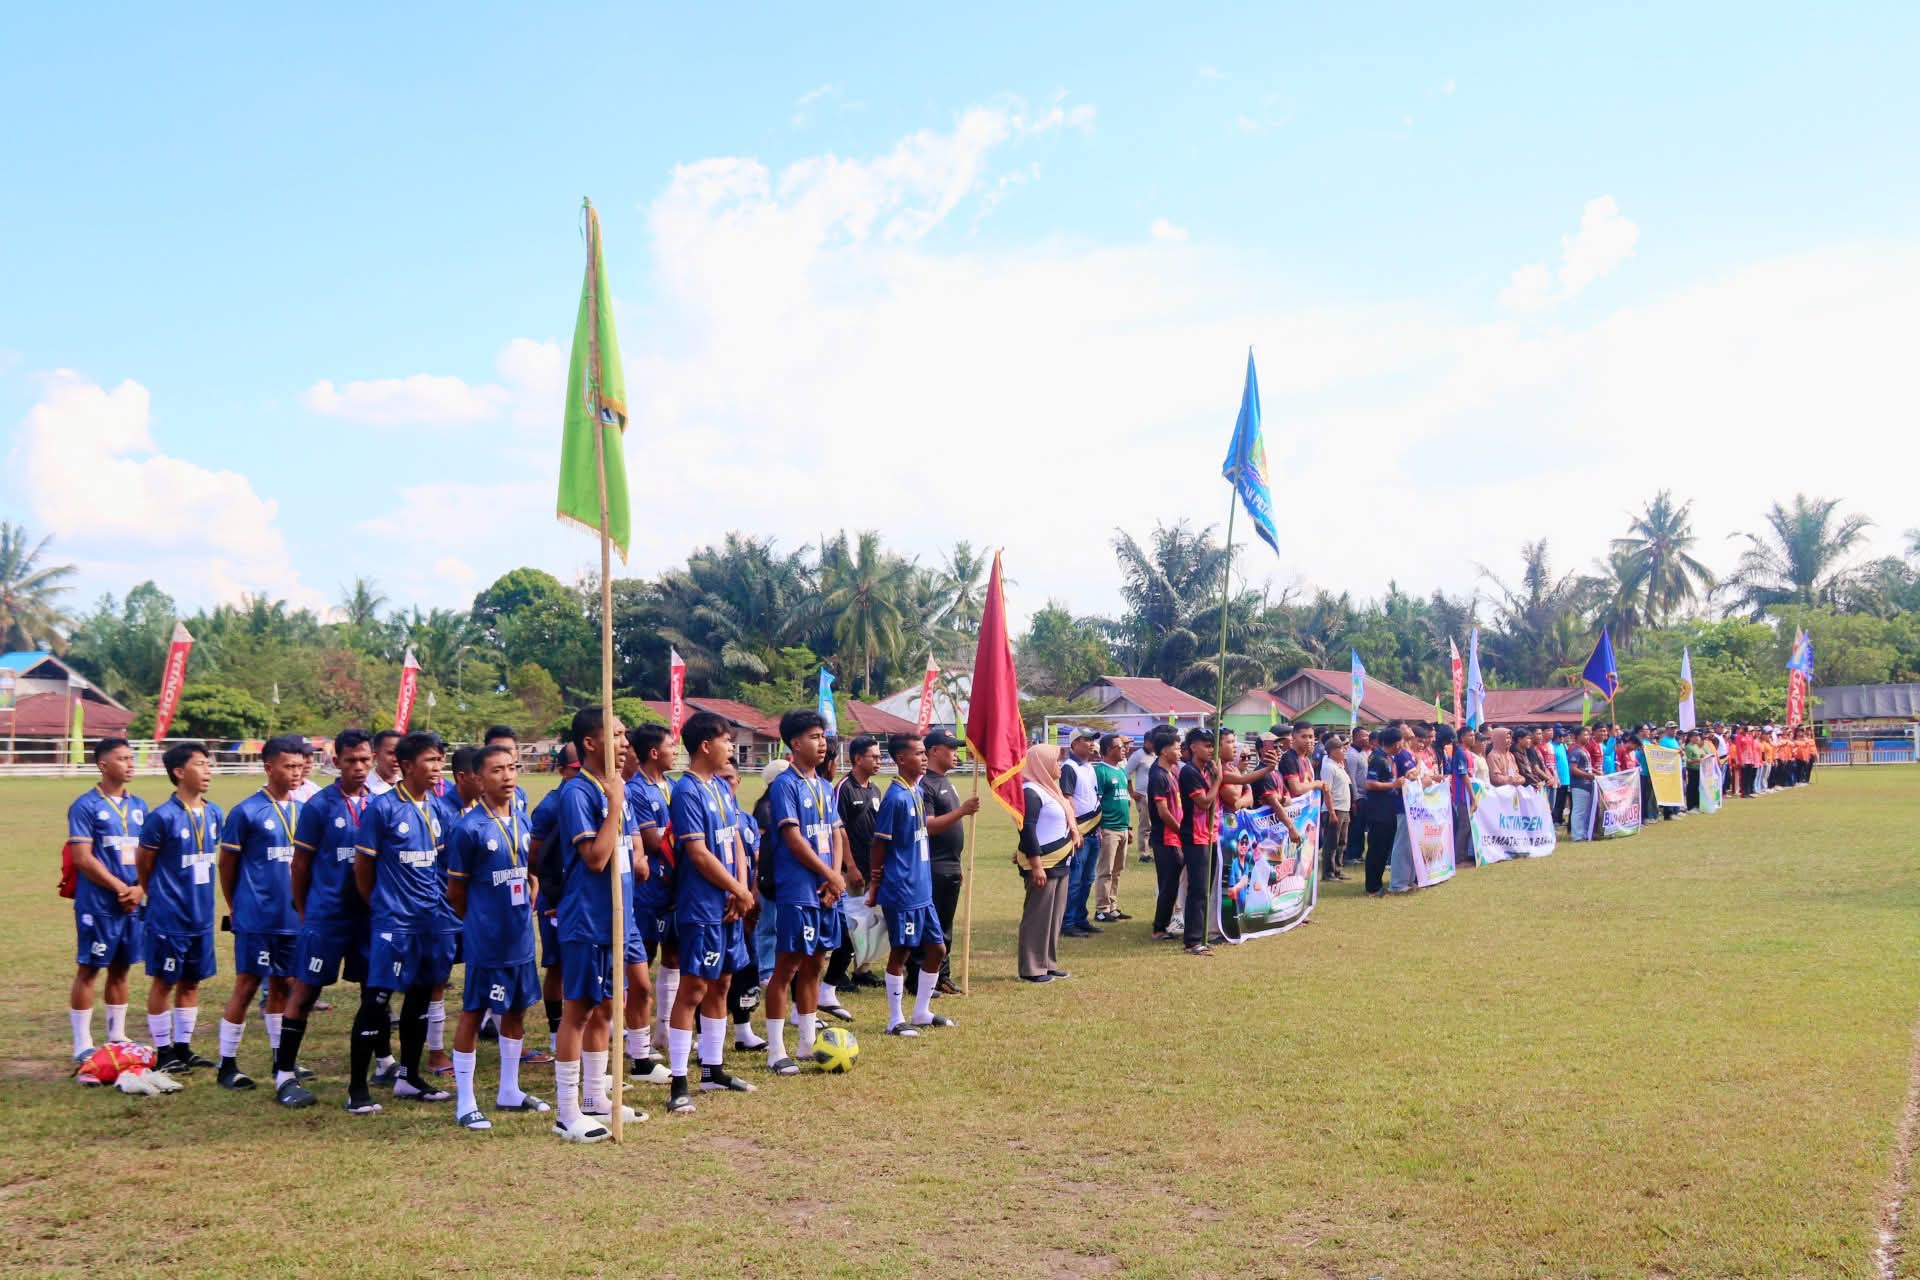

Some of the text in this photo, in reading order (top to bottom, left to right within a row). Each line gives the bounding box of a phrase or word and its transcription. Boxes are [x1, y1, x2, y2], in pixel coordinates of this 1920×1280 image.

[160, 650, 184, 718] HONDA
[308, 957, 323, 973] 10
[703, 951, 720, 966] 27
[489, 984, 505, 1002] 26
